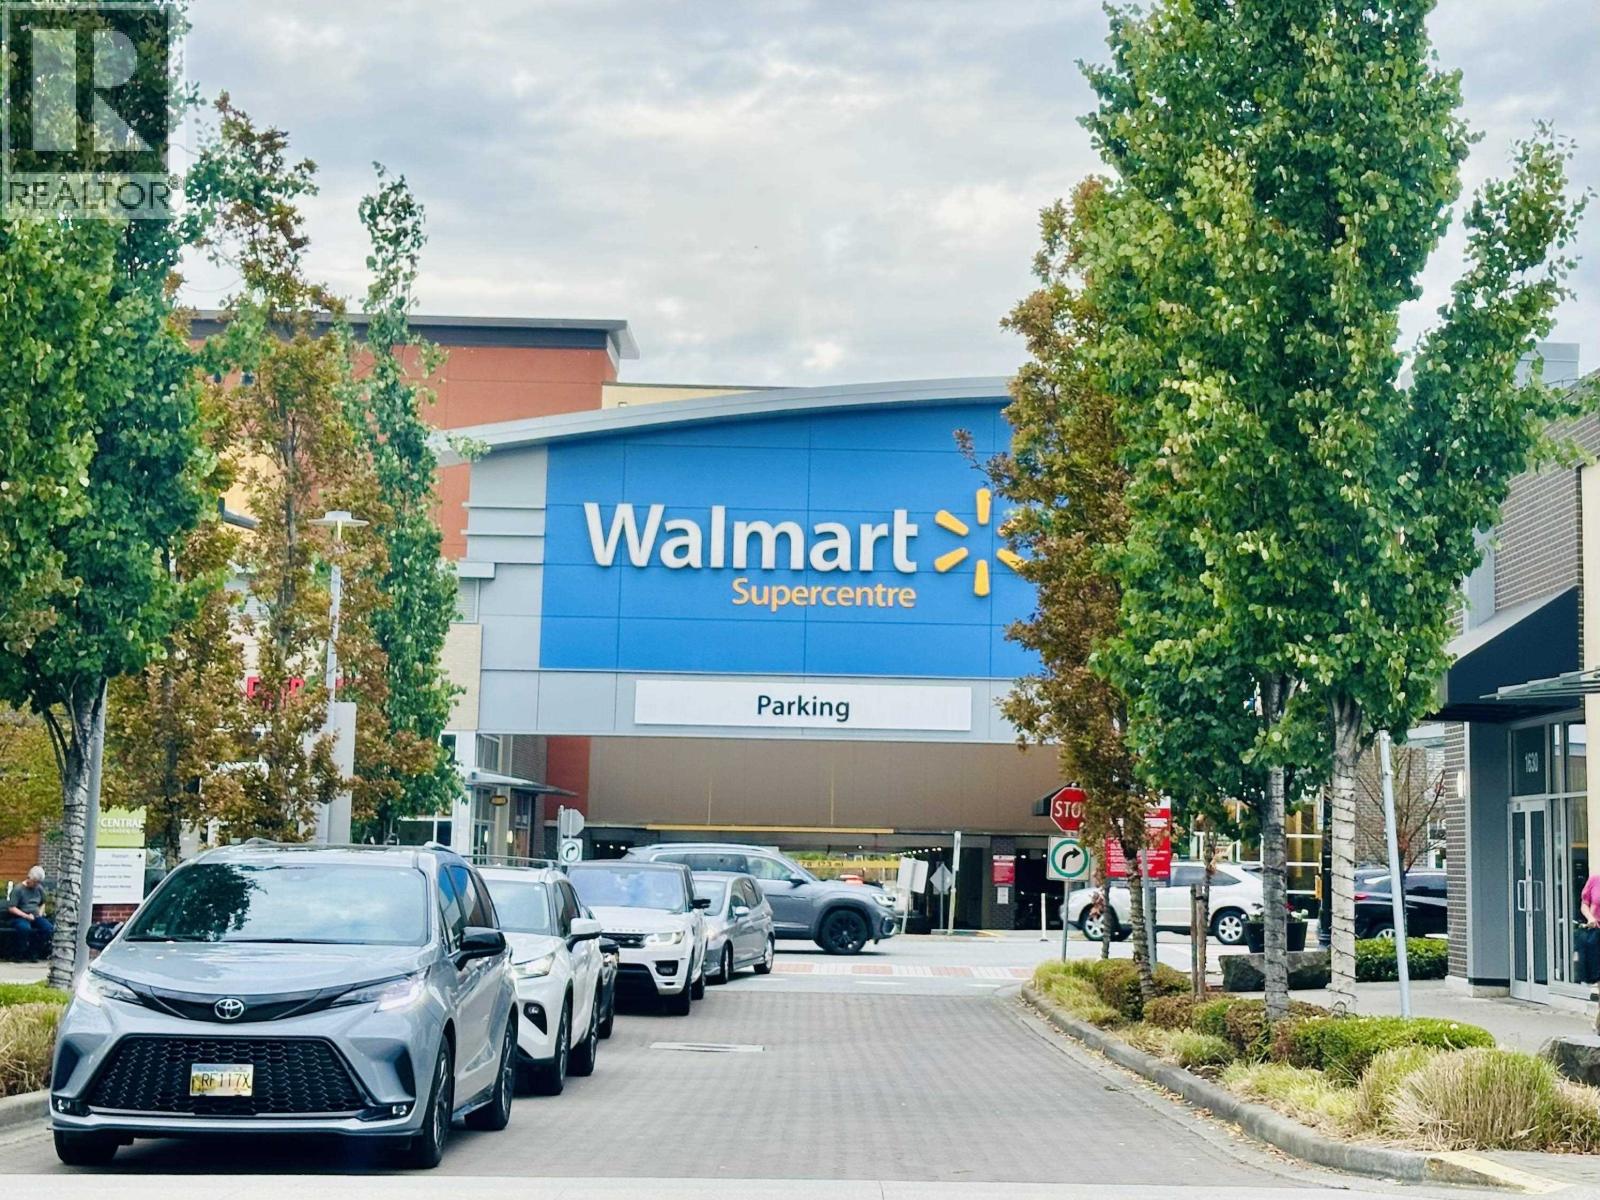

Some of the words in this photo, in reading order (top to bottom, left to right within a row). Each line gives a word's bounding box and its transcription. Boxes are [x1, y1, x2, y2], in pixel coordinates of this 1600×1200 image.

[584, 502, 919, 573] Walmart
[732, 577, 917, 612] Supercentre
[757, 695, 850, 722] Parking
[1054, 800, 1084, 818] STO
